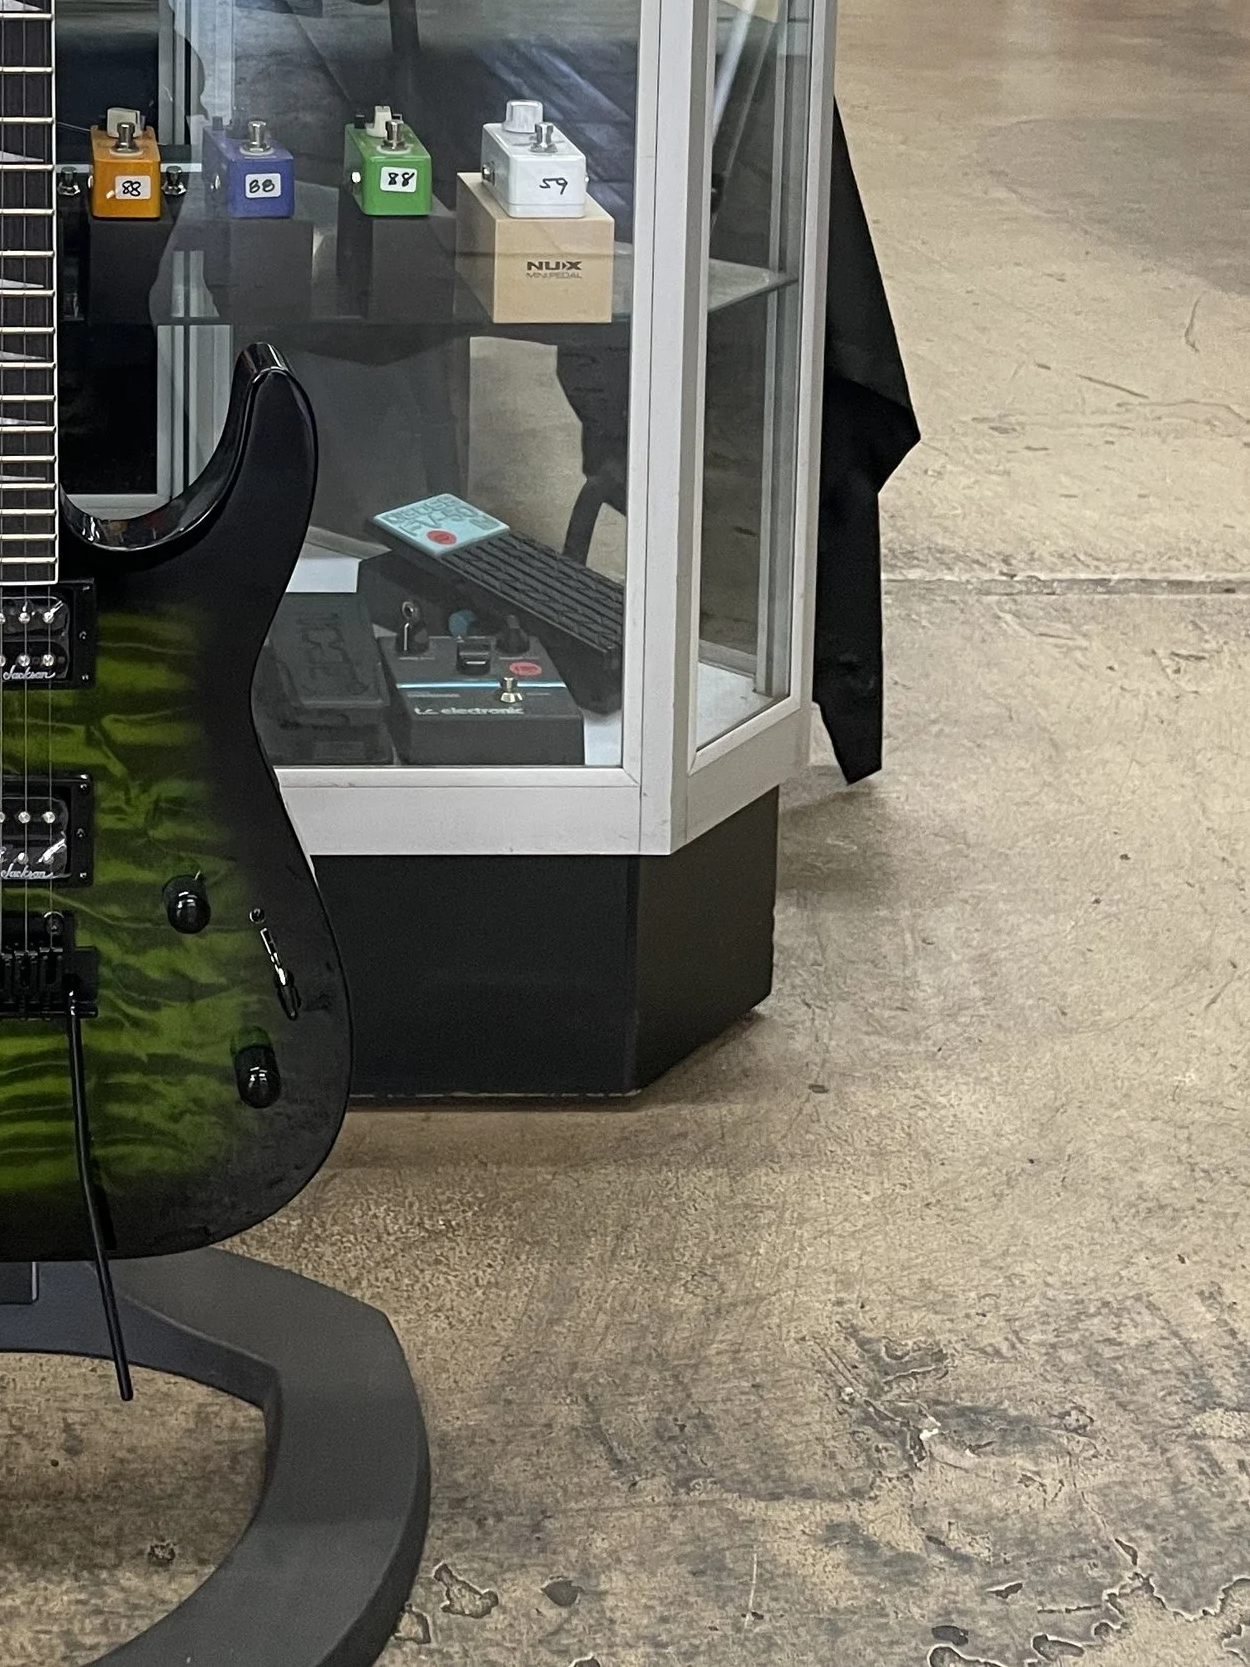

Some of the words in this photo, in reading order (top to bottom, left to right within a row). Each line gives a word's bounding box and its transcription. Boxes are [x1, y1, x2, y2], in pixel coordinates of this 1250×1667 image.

[388, 172, 415, 187] 88
[539, 177, 568, 195] 59
[122, 180, 141, 197] 88
[526, 261, 582, 271] NUX
[2, 664, 56, 681] Jackson
[441, 706, 525, 715] electronic
[0, 863, 54, 880] Jackson
